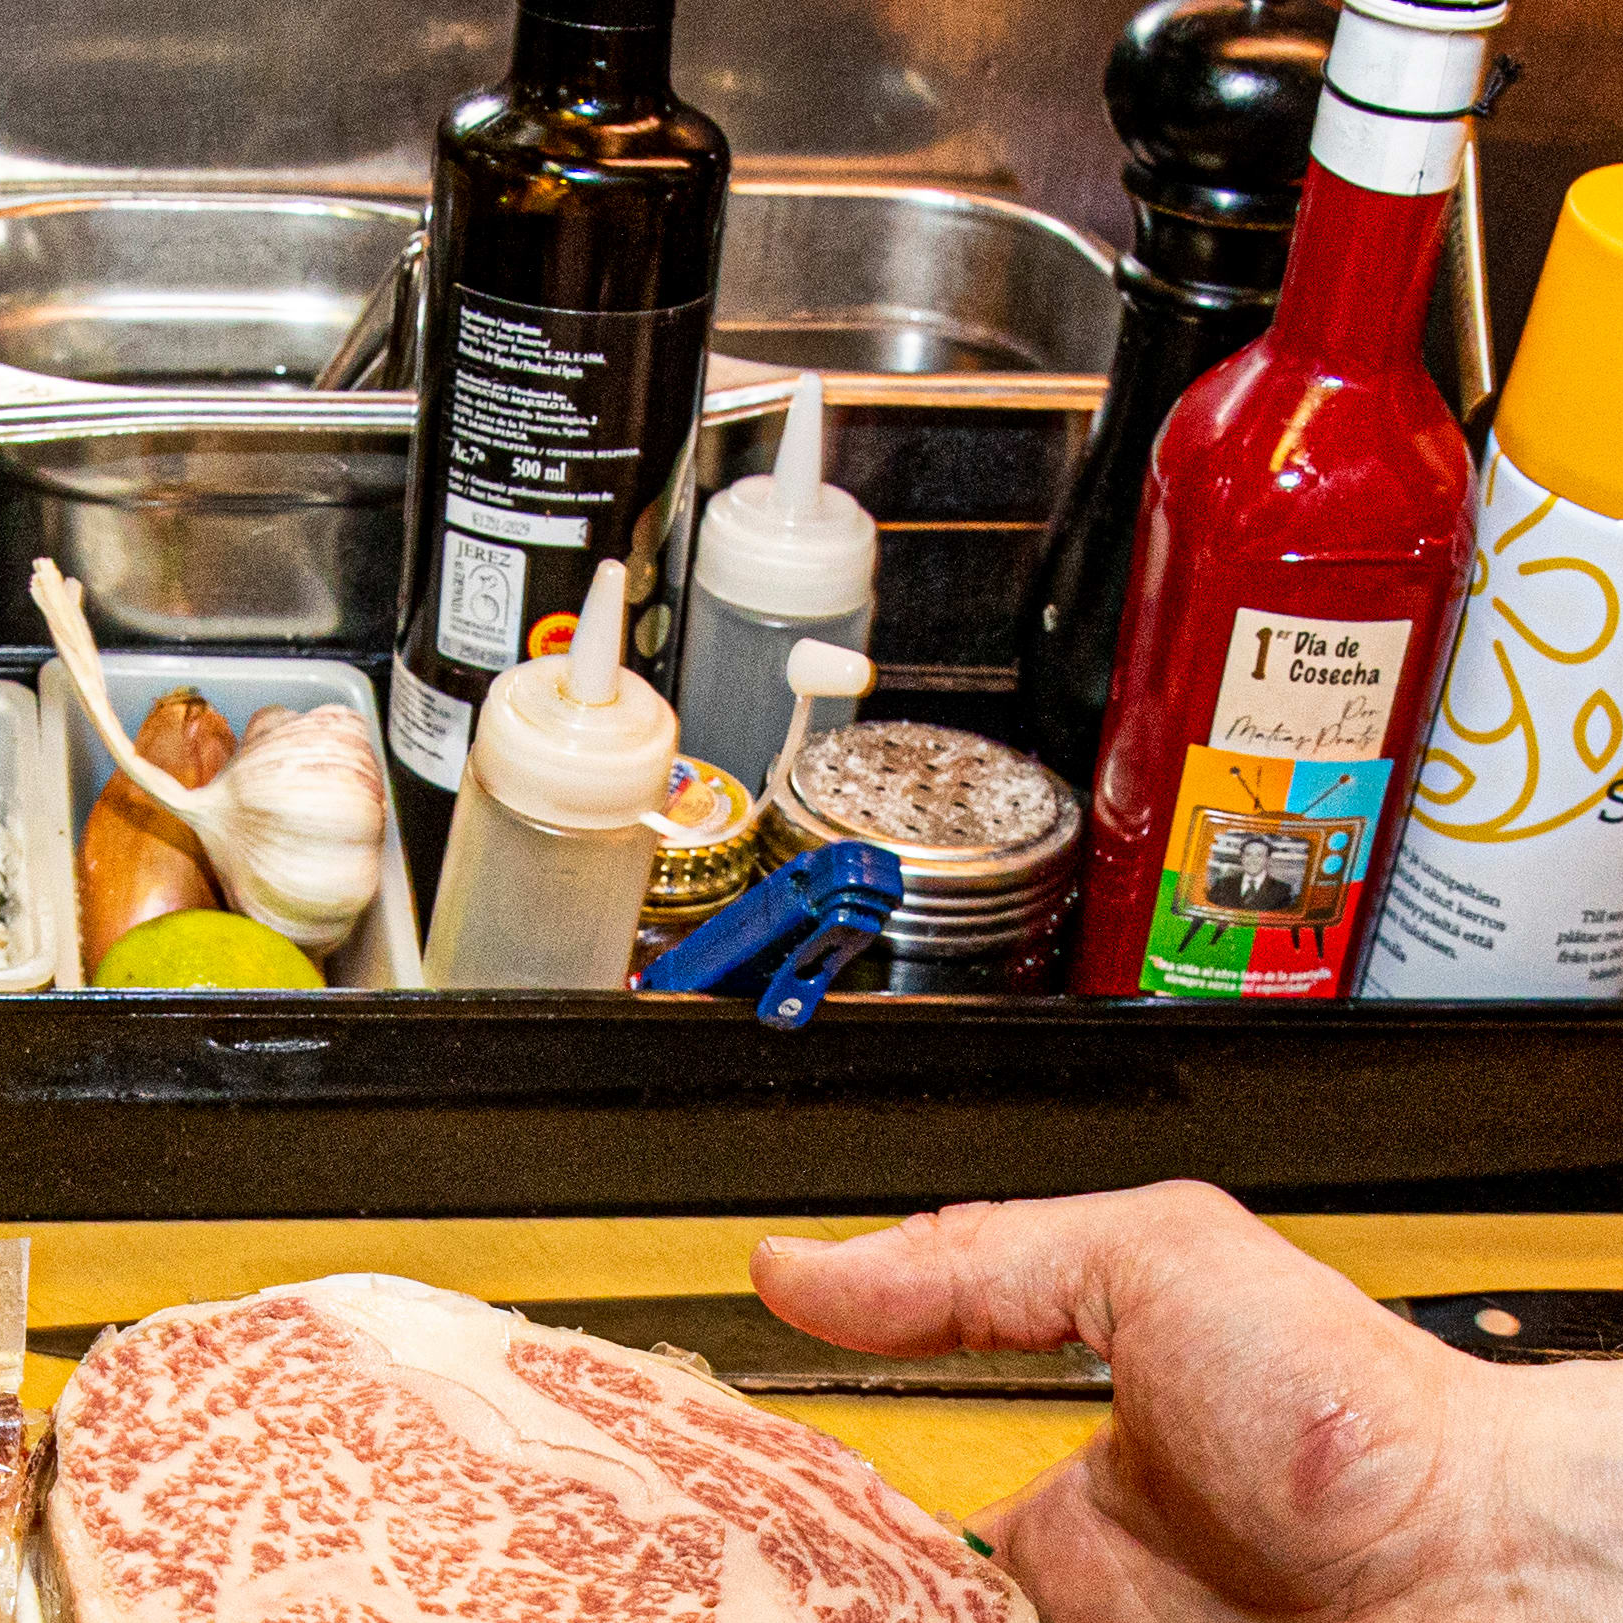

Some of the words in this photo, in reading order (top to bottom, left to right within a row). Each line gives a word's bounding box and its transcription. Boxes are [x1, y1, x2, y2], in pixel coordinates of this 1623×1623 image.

[511, 456, 541, 480] 500
[544, 461, 567, 483] ml
[456, 540, 511, 568] JEREZ
[1294, 631, 1326, 657] Día
[1335, 636, 1360, 658] de
[1289, 659, 1380, 686] Cosecha
